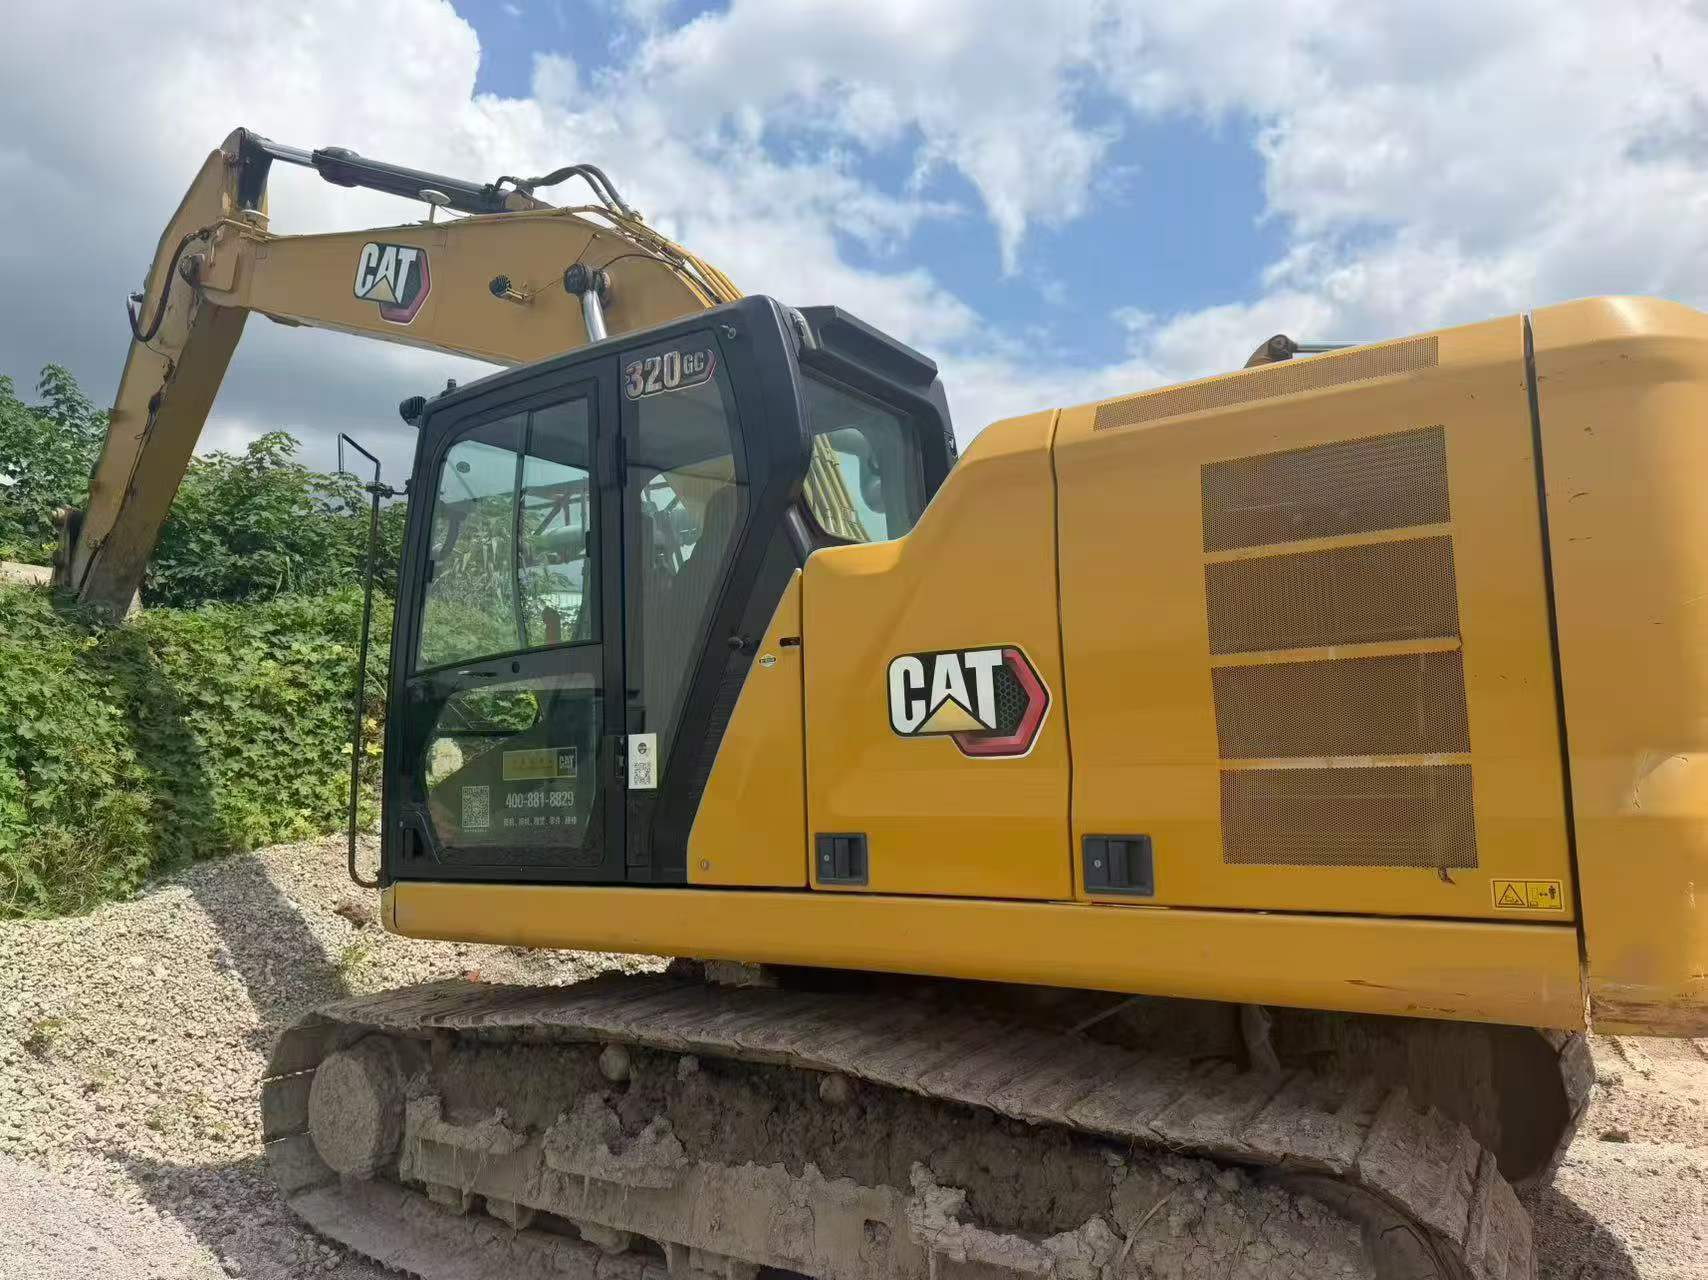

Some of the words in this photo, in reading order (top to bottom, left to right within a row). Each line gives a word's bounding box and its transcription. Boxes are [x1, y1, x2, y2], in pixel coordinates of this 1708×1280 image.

[355, 243, 418, 304] CAT
[625, 351, 681, 397] 320
[683, 352, 704, 374] GC
[889, 649, 1003, 734] CAT
[506, 791, 575, 808] 400-881-8829
